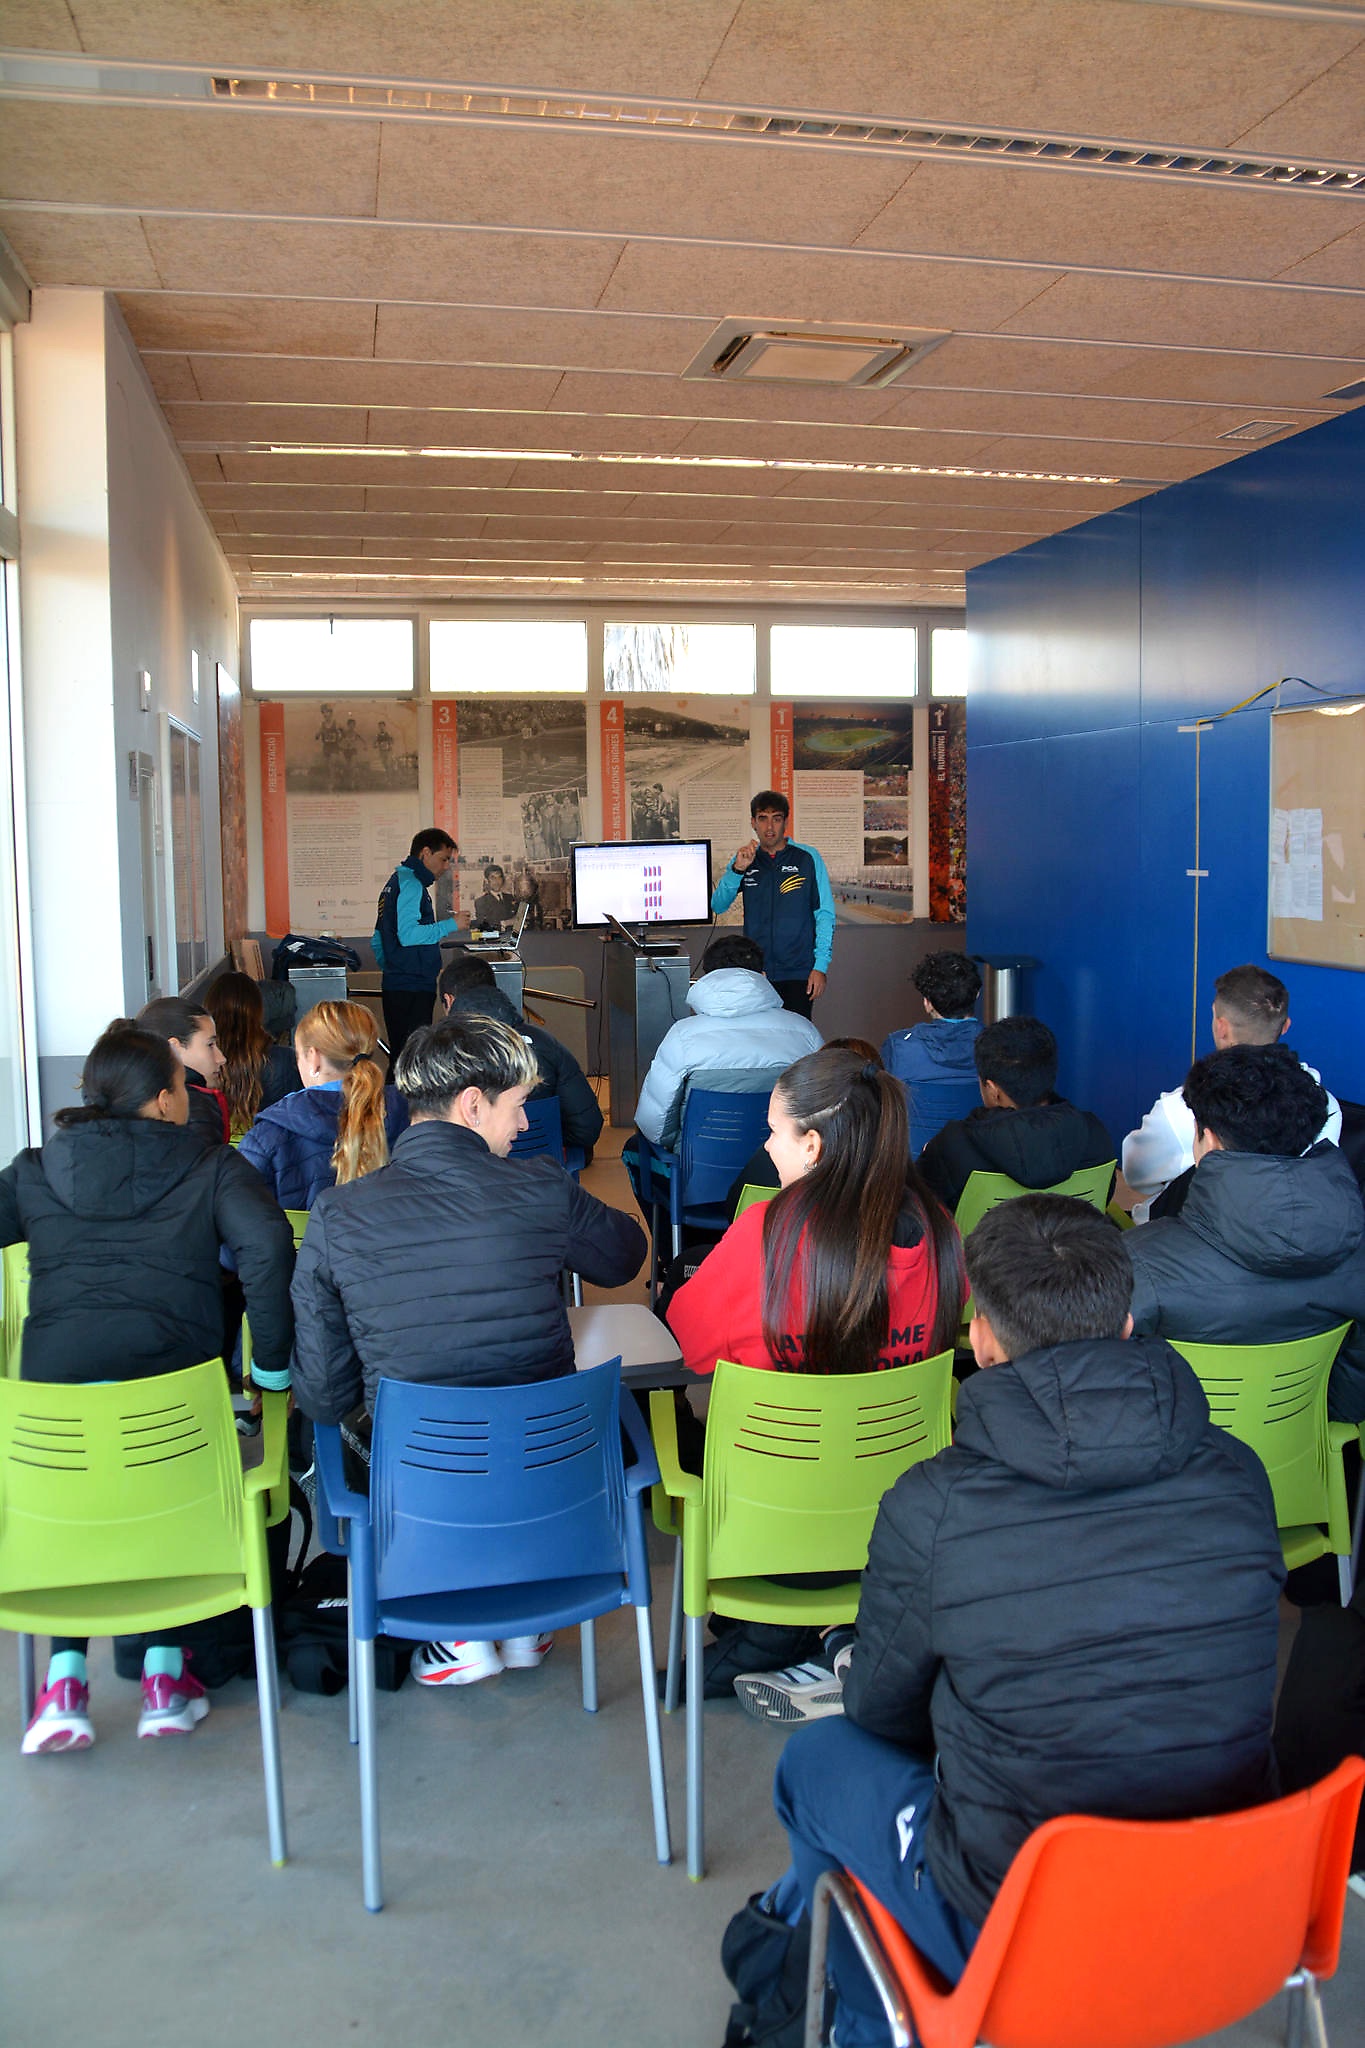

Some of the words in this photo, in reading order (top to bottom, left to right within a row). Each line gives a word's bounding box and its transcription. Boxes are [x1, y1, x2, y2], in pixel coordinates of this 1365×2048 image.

[439, 706, 450, 724] 3
[606, 706, 618, 724] 4
[937, 735, 946, 770] RUNNING
